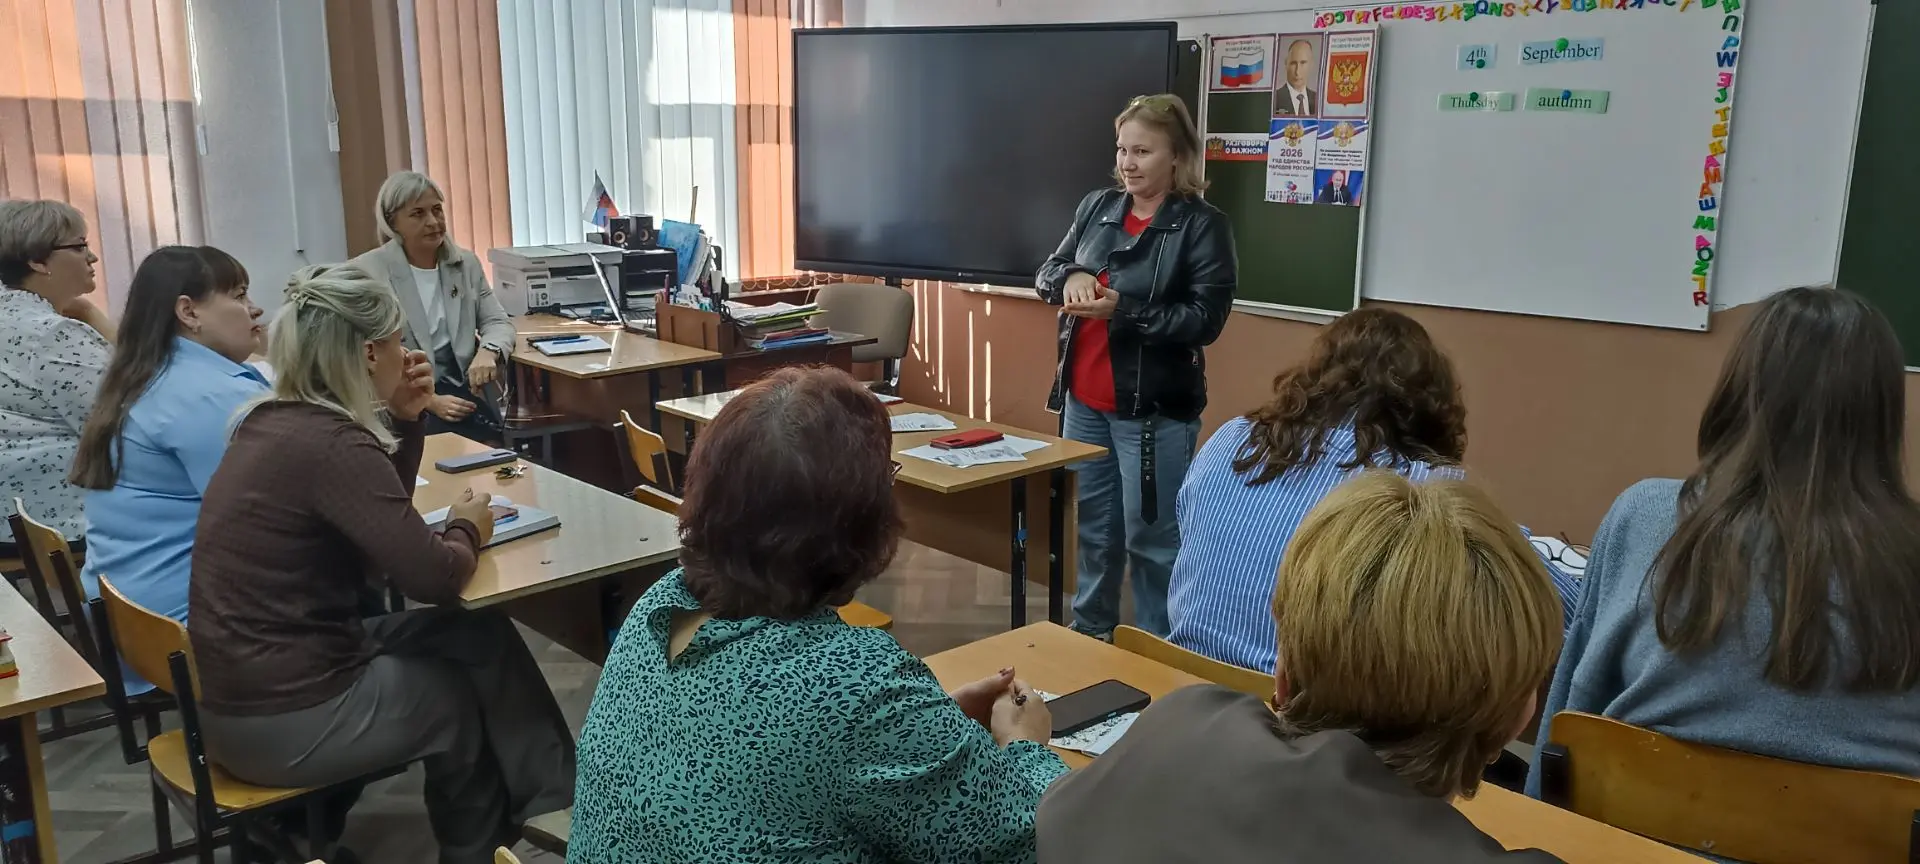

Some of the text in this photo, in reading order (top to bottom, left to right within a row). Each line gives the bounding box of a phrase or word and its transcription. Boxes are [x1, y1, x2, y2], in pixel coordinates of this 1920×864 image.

[1465, 43, 1600, 66] 4th September
[1450, 95, 1592, 111] Thursday autumn
[1232, 147, 1263, 155] ВАЖНОМ
[1280, 148, 1303, 158] 2026
